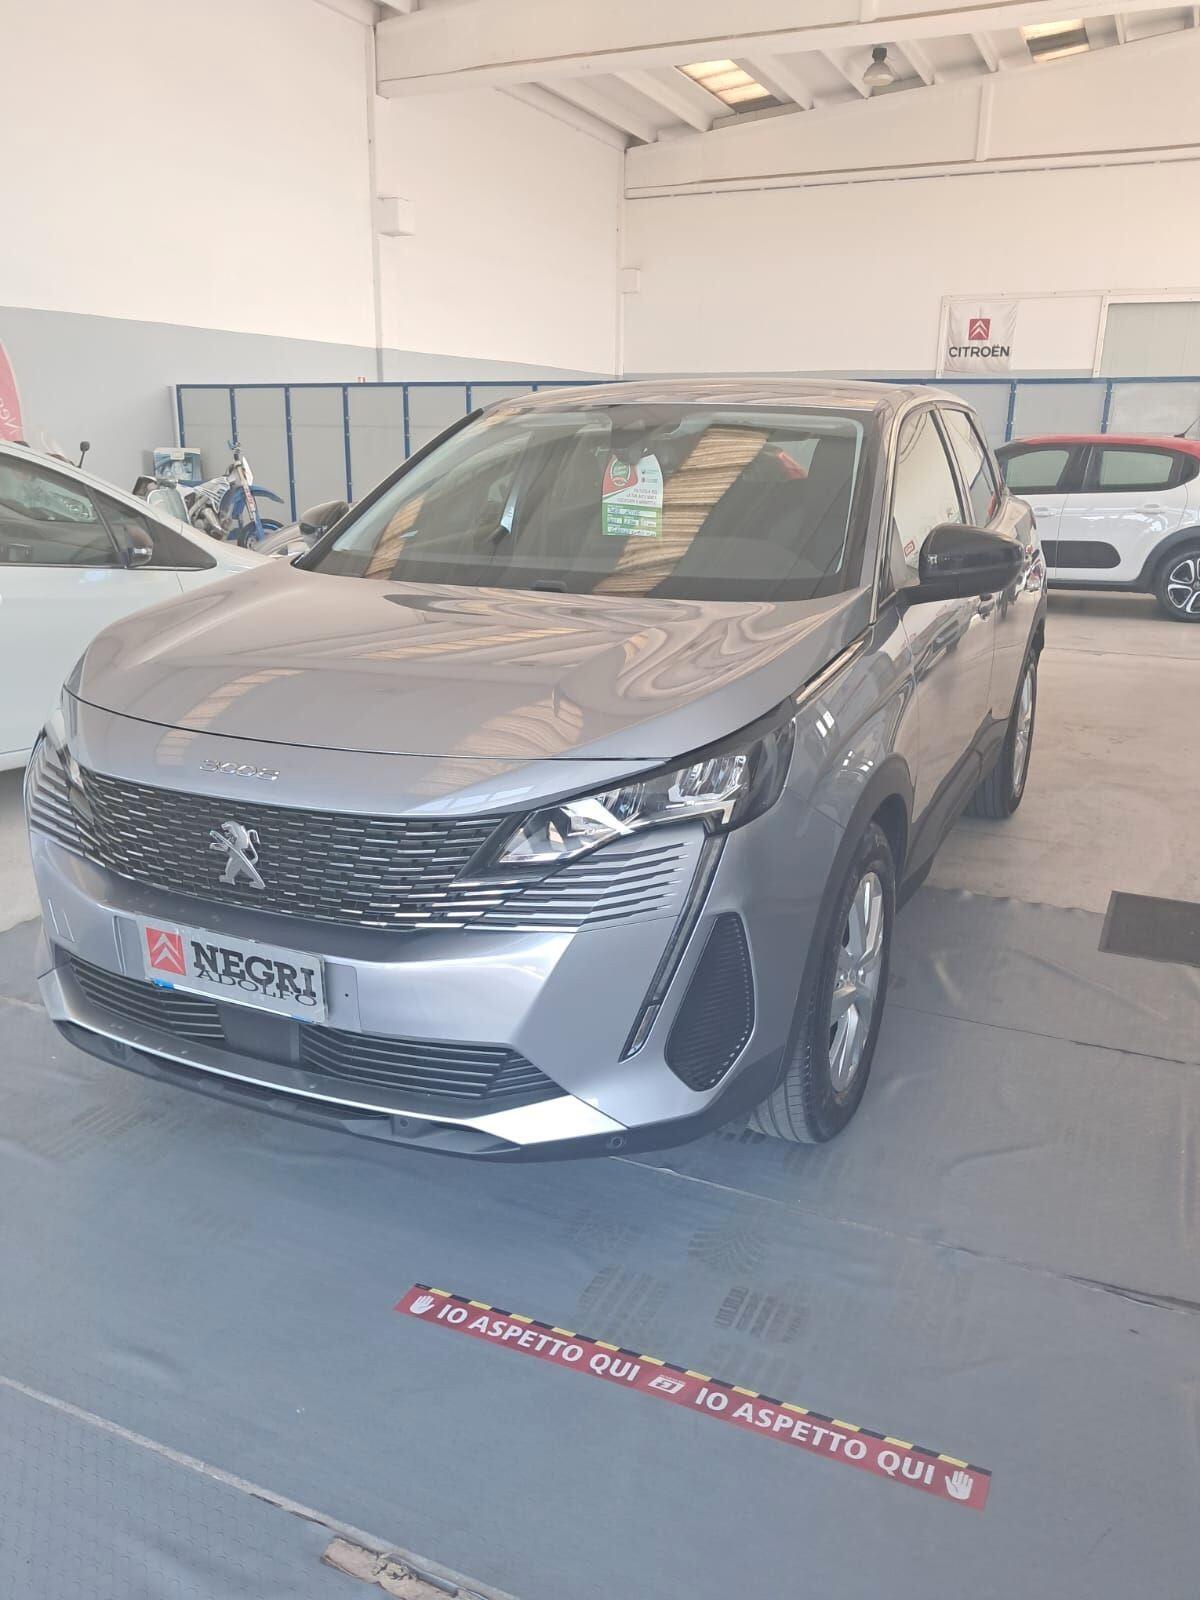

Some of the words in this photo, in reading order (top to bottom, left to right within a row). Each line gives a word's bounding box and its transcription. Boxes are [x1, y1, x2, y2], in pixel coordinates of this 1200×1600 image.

[949, 344, 1010, 358] CITROËN
[190, 940, 317, 998] NEGRI
[194, 967, 318, 1007] ADOLFO
[437, 1303, 468, 1324] IO
[468, 1315, 583, 1362] ASPETTO
[589, 1353, 641, 1382] QUI
[694, 1387, 728, 1411] IO
[732, 1402, 867, 1460] ASPETTO
[876, 1450, 936, 1485] QUI
